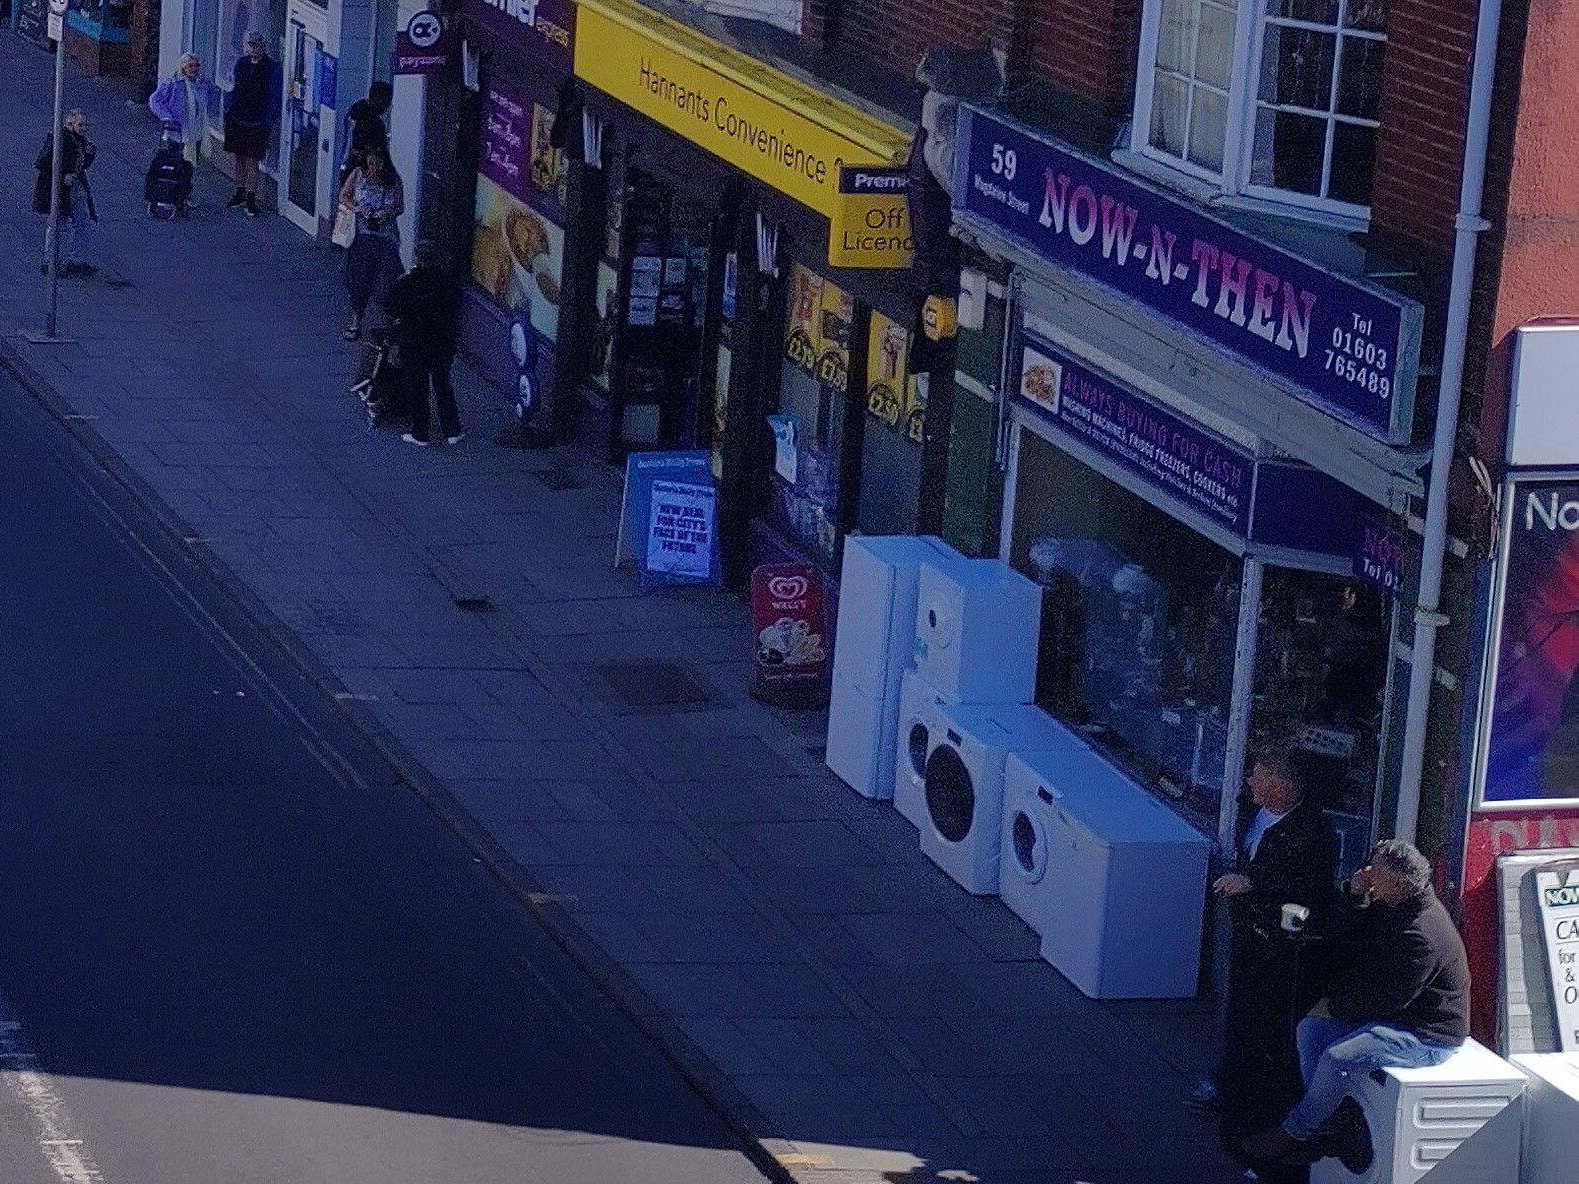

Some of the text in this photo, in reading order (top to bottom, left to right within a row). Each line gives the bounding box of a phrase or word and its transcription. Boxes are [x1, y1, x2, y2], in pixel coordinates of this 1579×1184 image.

[638, 56, 710, 123] Hannants
[714, 96, 827, 185] Convenience
[991, 143, 1017, 181] 59
[865, 207, 906, 228] Off
[1038, 167, 1318, 359] NOW-N-THEN
[1351, 312, 1373, 336] Tel
[1332, 326, 1387, 370] 01603
[1324, 348, 1391, 399] 765489
[1172, 433, 1200, 461] FOR
